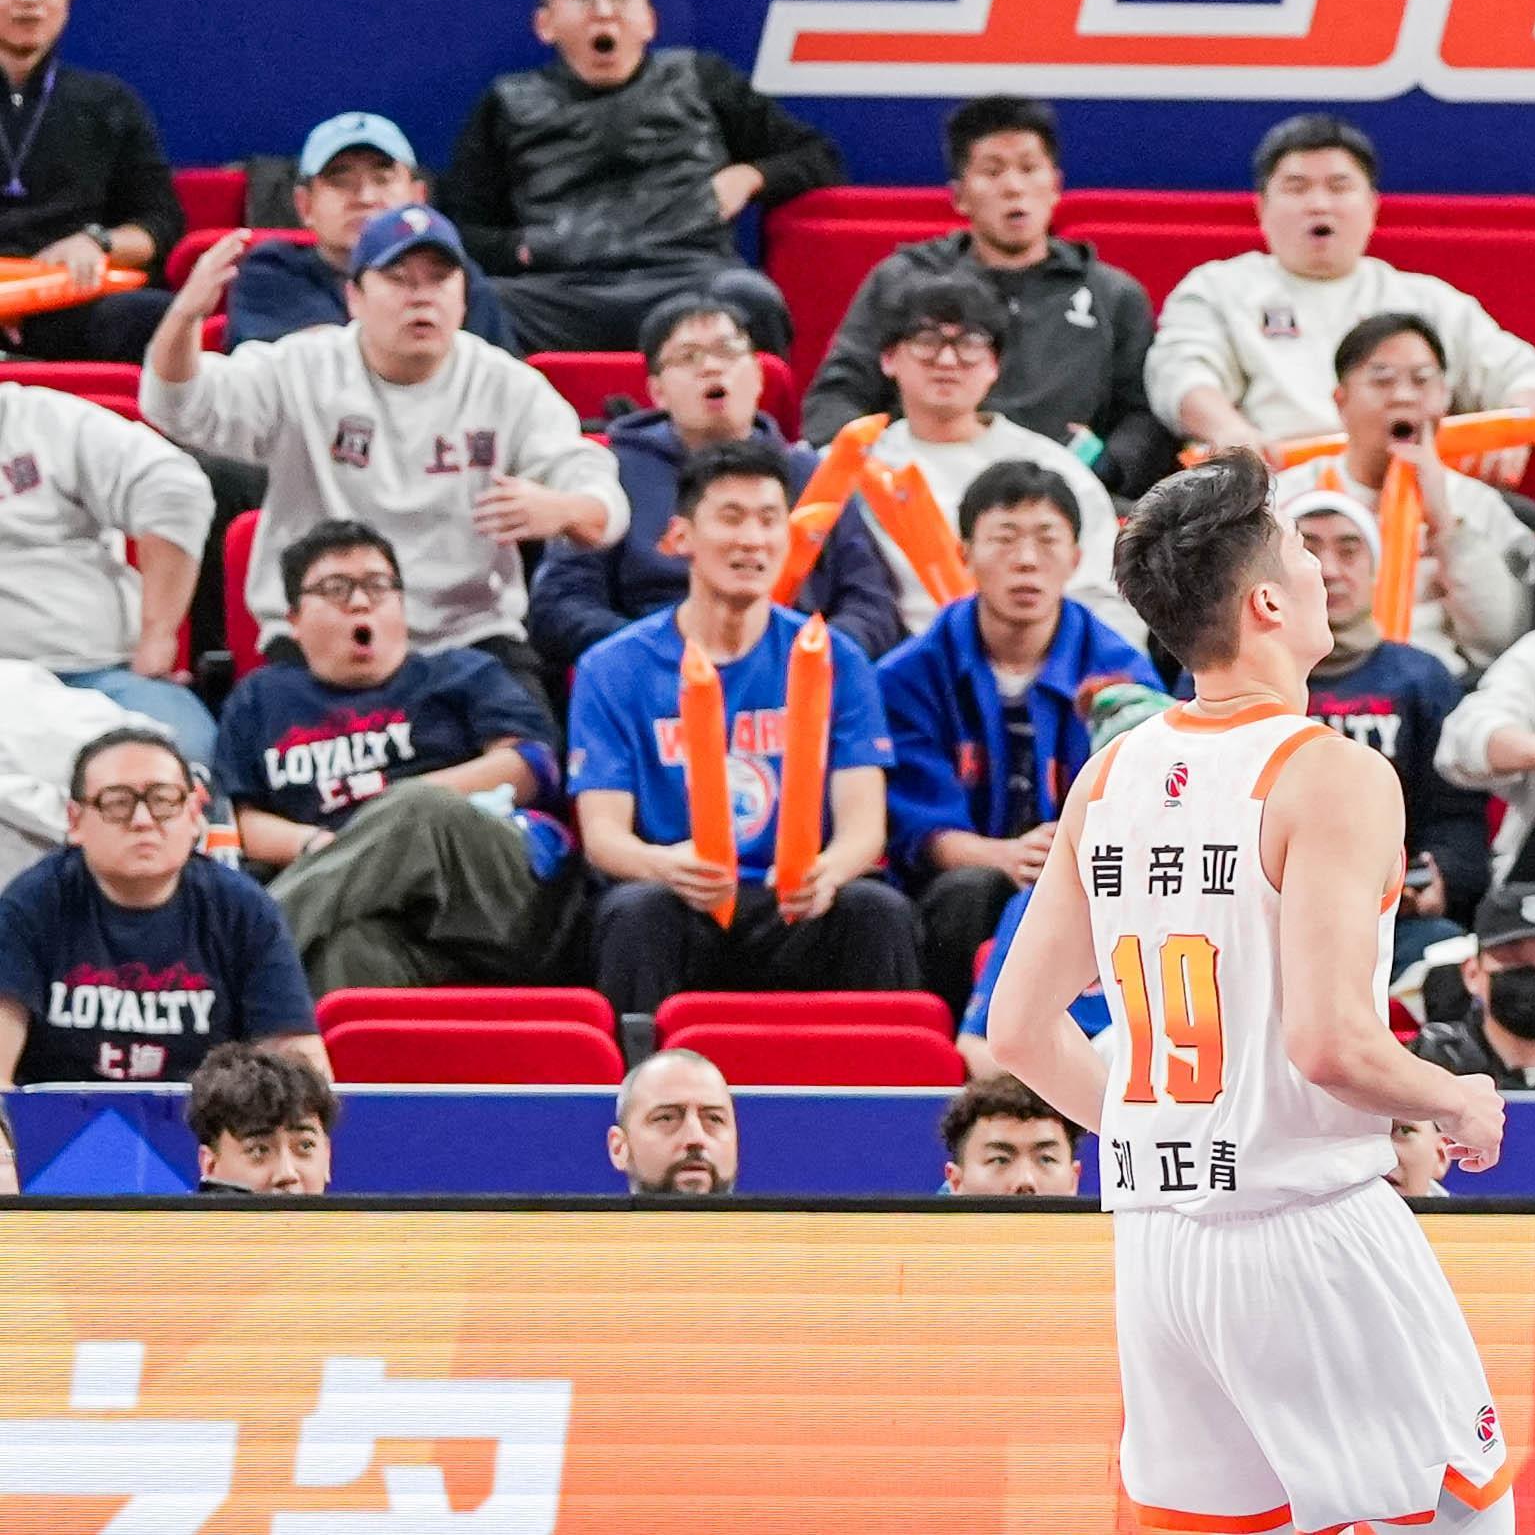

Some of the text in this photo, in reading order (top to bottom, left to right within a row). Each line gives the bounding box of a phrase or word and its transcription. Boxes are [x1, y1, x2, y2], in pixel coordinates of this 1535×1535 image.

[264, 722, 415, 790] LOYALTY
[1091, 844, 1238, 897] 肯帝亚
[48, 981, 216, 1035] LOYALTY
[1111, 934, 1222, 1104] 19
[1112, 1139, 1236, 1191] 刘正青
